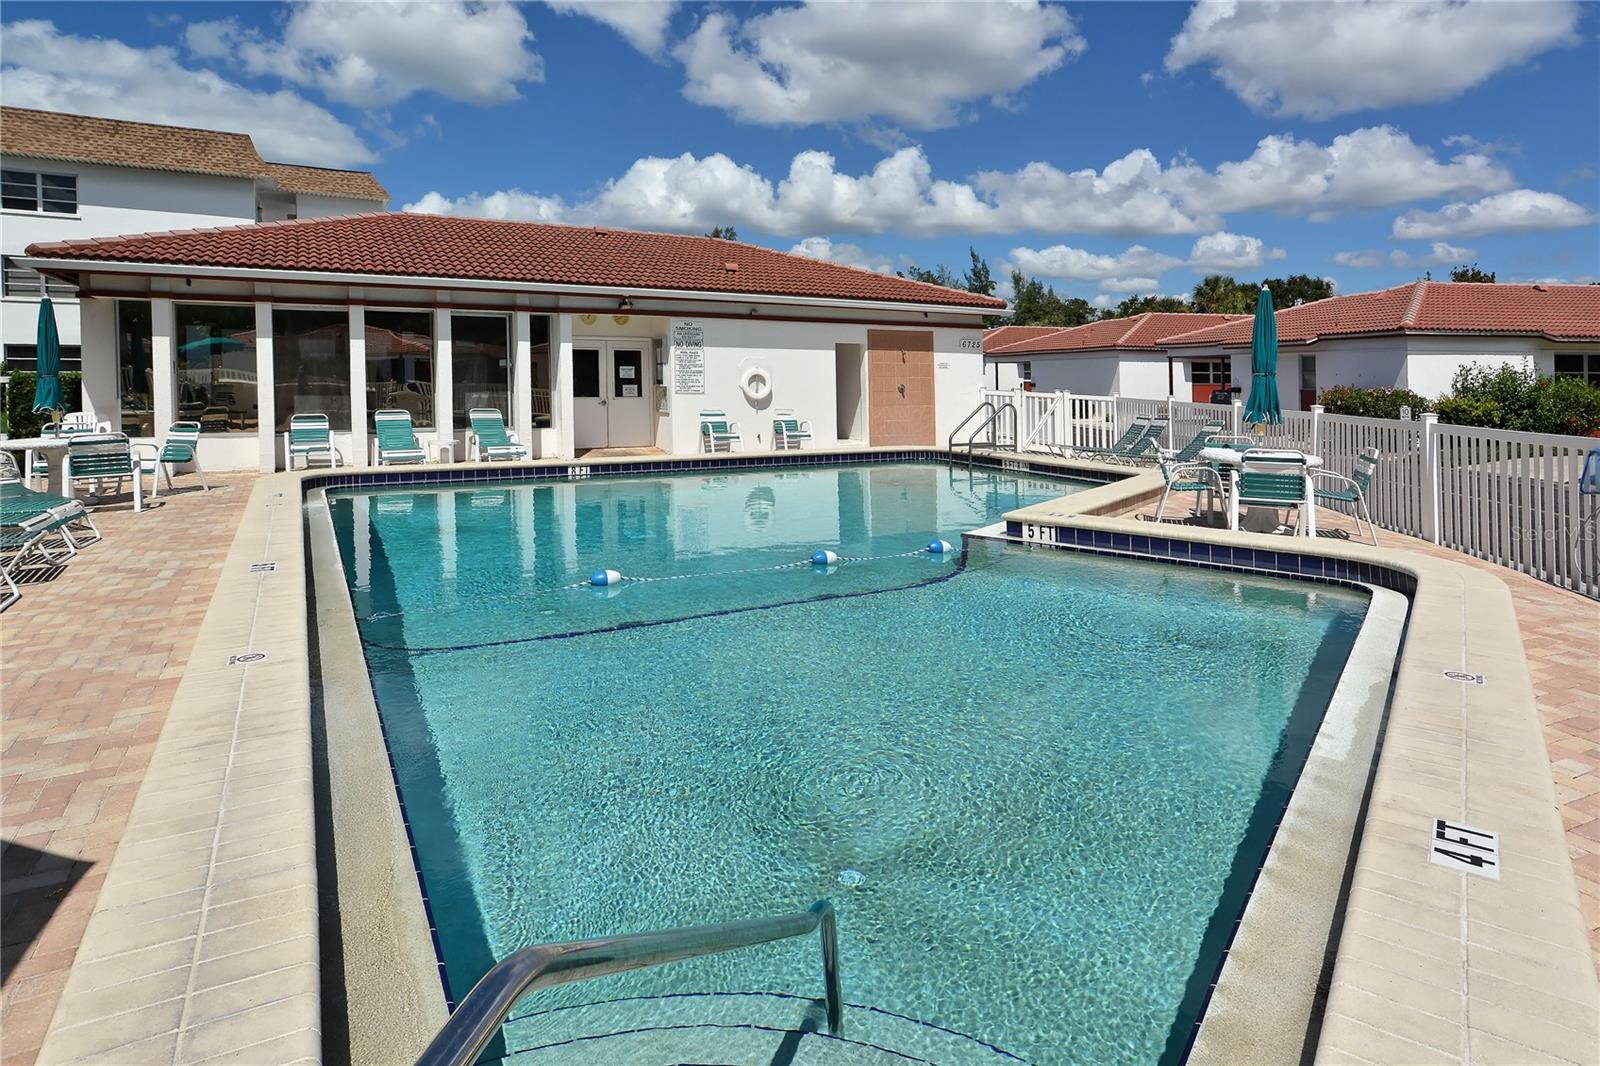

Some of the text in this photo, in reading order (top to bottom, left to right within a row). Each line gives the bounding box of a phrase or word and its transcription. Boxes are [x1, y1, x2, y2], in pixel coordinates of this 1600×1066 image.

[685, 340, 702, 348] DIVING
[962, 340, 981, 348] 6725
[1401, 408, 1410, 416] 10
[571, 466, 576, 474] 8
[1028, 524, 1054, 541] 5 FT
[1434, 819, 1495, 868] 4 FT
